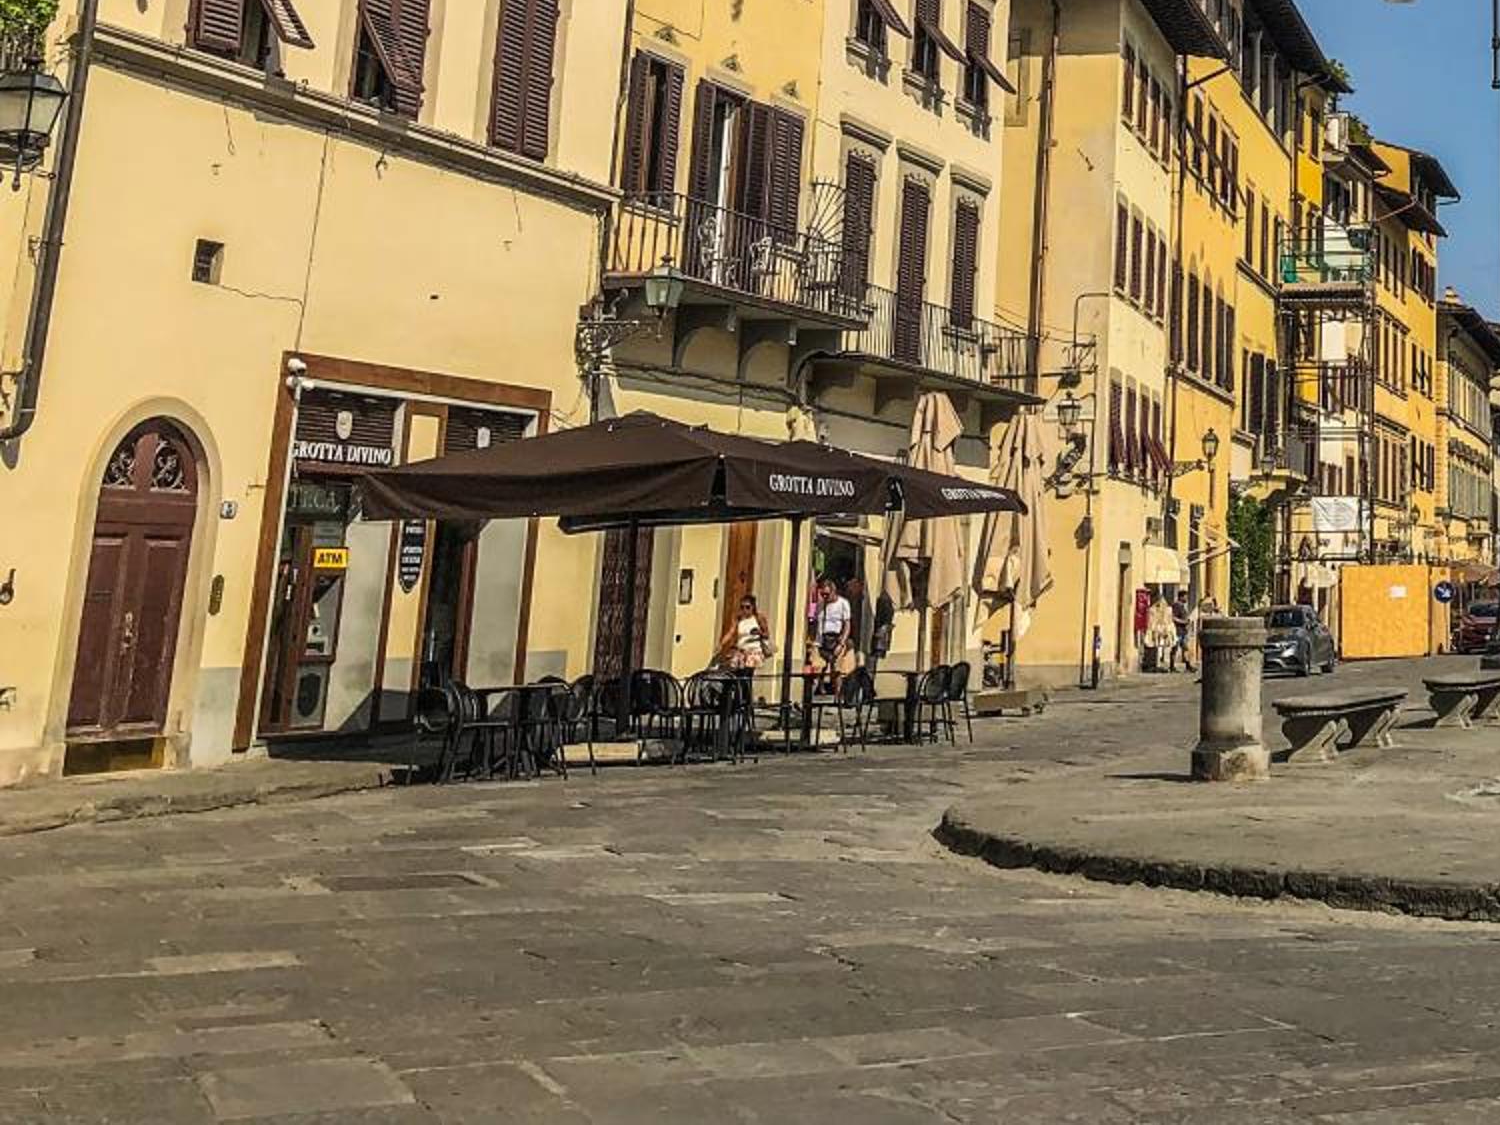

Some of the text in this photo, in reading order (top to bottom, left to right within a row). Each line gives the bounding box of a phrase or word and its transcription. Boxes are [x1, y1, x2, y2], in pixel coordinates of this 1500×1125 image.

[346, 443, 392, 465] DIVINO
[769, 474, 855, 497] GROTTA DIVINO
[317, 551, 343, 564] ATM
